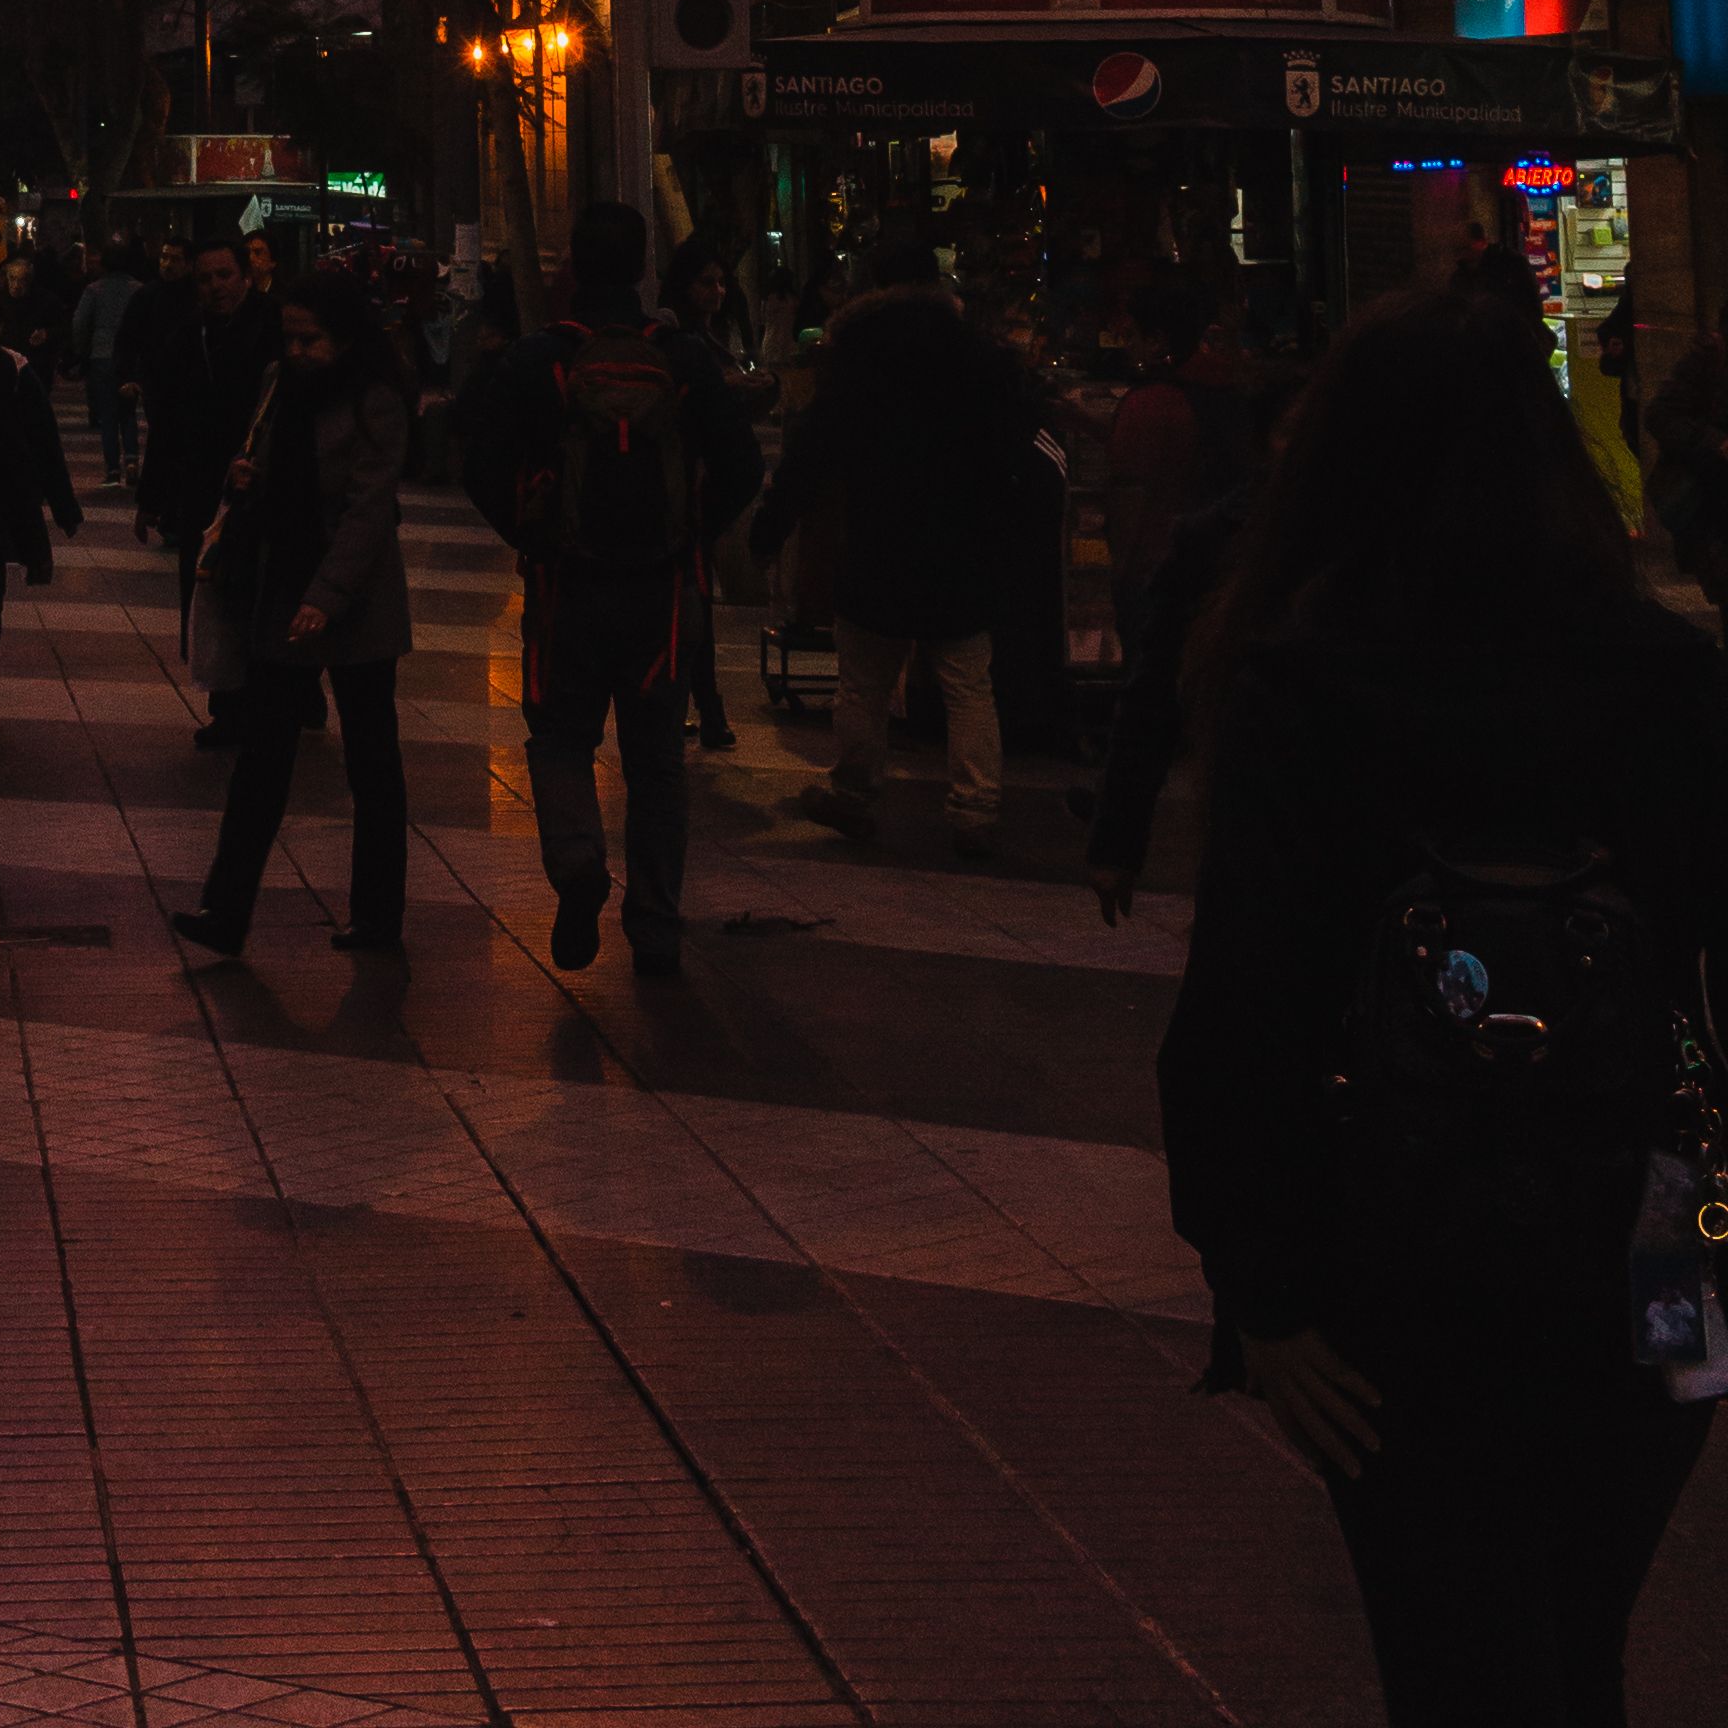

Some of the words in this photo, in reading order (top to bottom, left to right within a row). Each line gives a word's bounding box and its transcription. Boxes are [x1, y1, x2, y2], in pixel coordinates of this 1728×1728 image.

[775, 76, 884, 94] SANTIAGO
[1330, 76, 1446, 96] SANTIAGO
[836, 100, 974, 120] Municipalidad
[1397, 101, 1522, 123] Municipalidad
